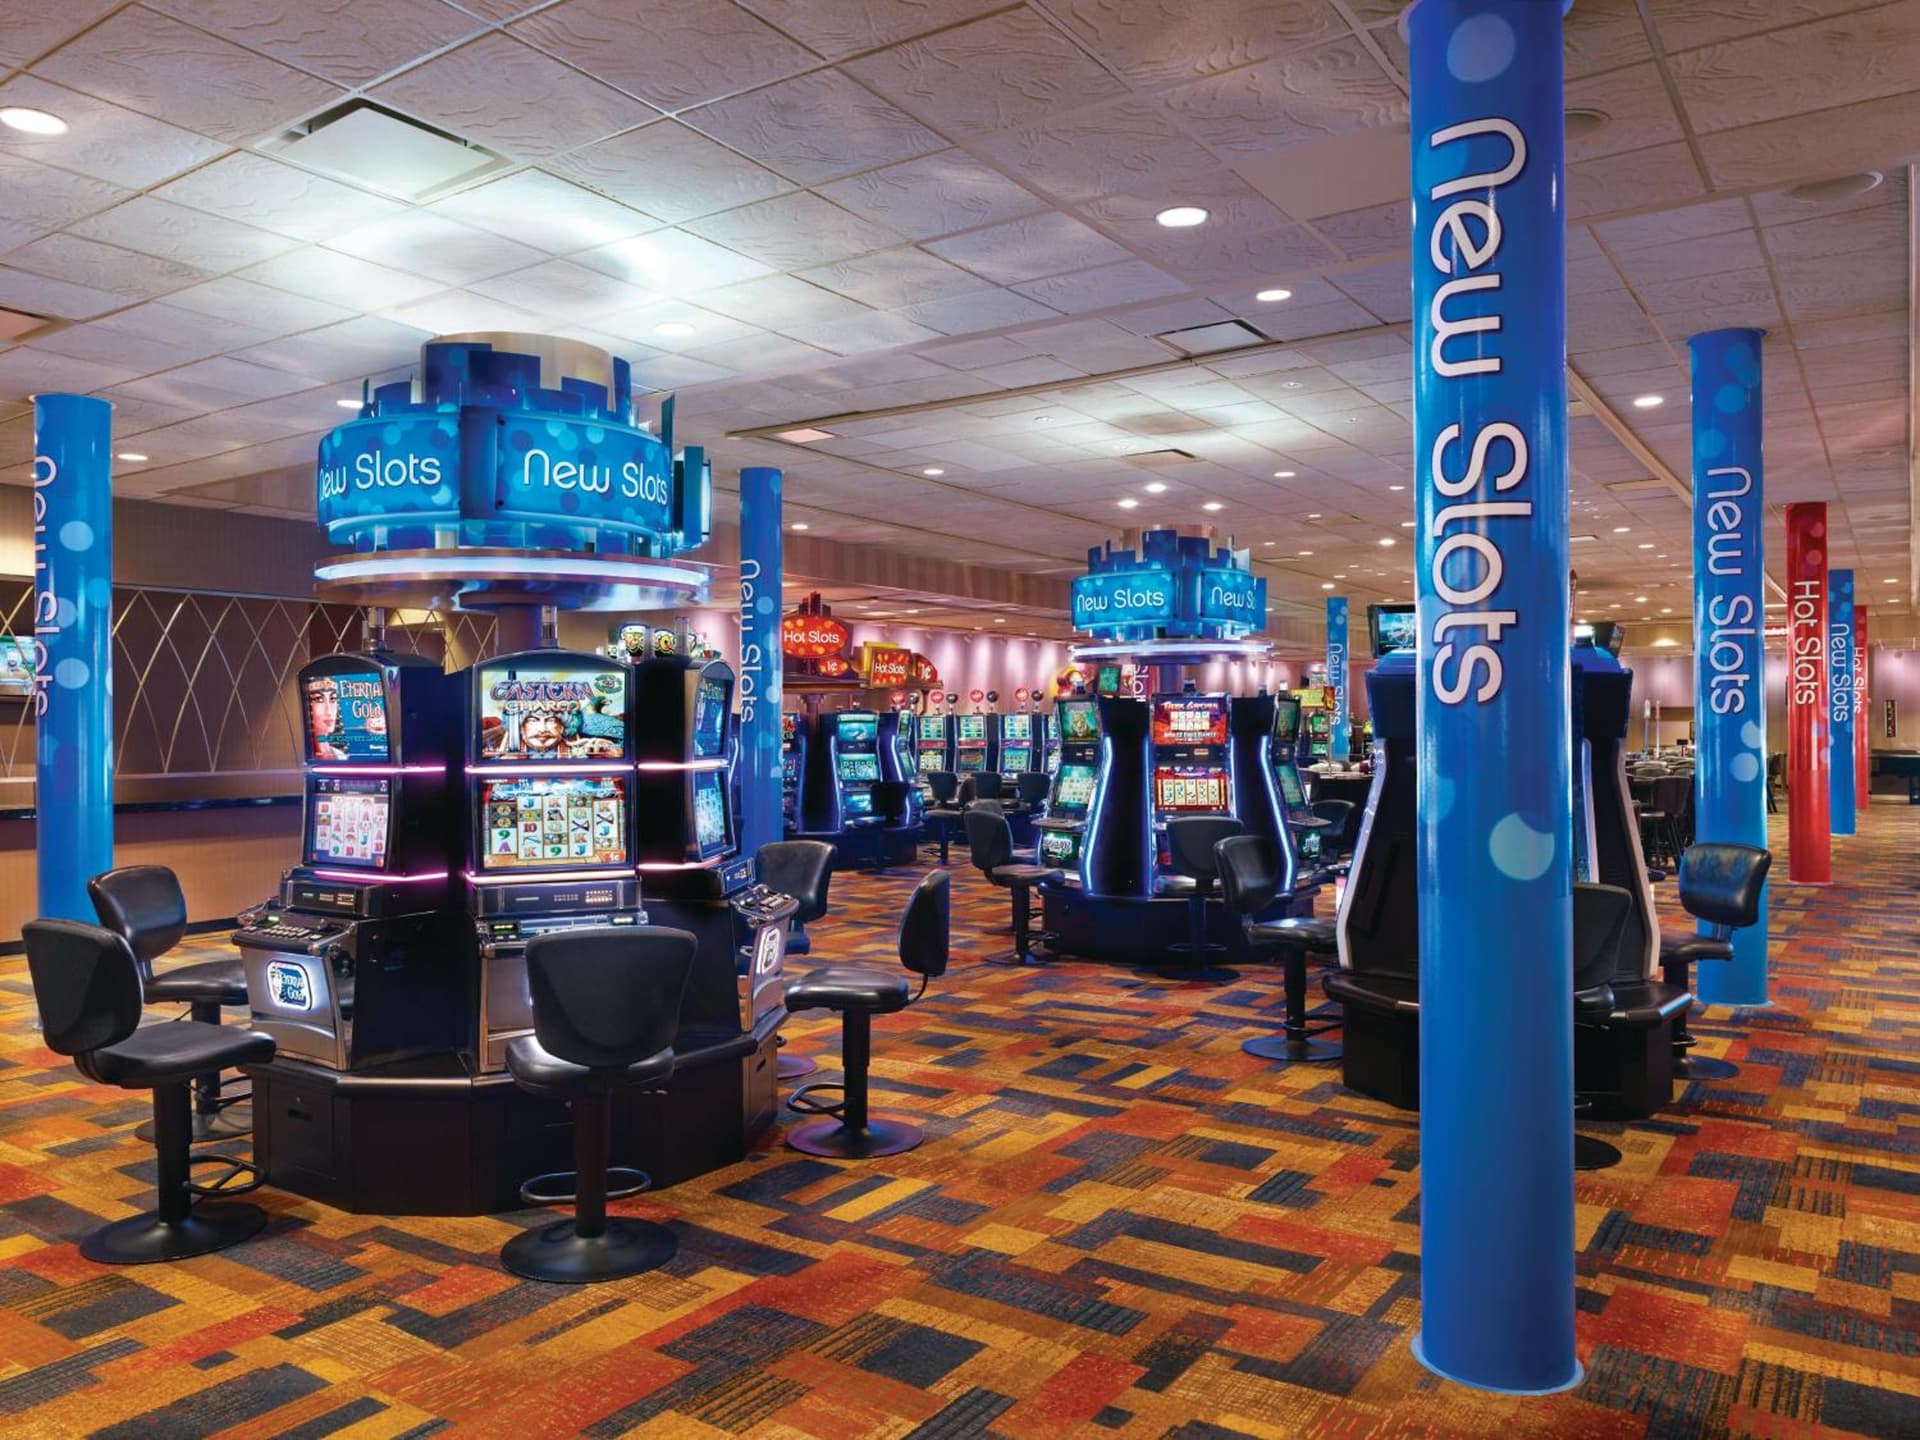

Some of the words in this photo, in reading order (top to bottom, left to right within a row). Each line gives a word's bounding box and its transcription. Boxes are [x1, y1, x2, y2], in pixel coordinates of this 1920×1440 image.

[1430, 117, 1528, 379] New
[355, 449, 441, 490] Slots
[523, 449, 610, 493] New
[621, 461, 668, 505] Slots
[1706, 467, 1752, 576] New
[1431, 421, 1532, 706] Slots
[1077, 594, 1108, 613] New
[1114, 589, 1165, 609] Slots
[1212, 586, 1246, 608] New
[1793, 580, 1821, 628] Hot
[784, 630, 806, 643] Hot
[808, 630, 840, 644] Slots
[1708, 594, 1757, 715] Slots
[1831, 623, 1850, 668] New
[875, 663, 888, 674] Hot
[889, 663, 905, 674] Slots
[1795, 636, 1823, 705] Slots
[1832, 674, 1851, 722] Slots
